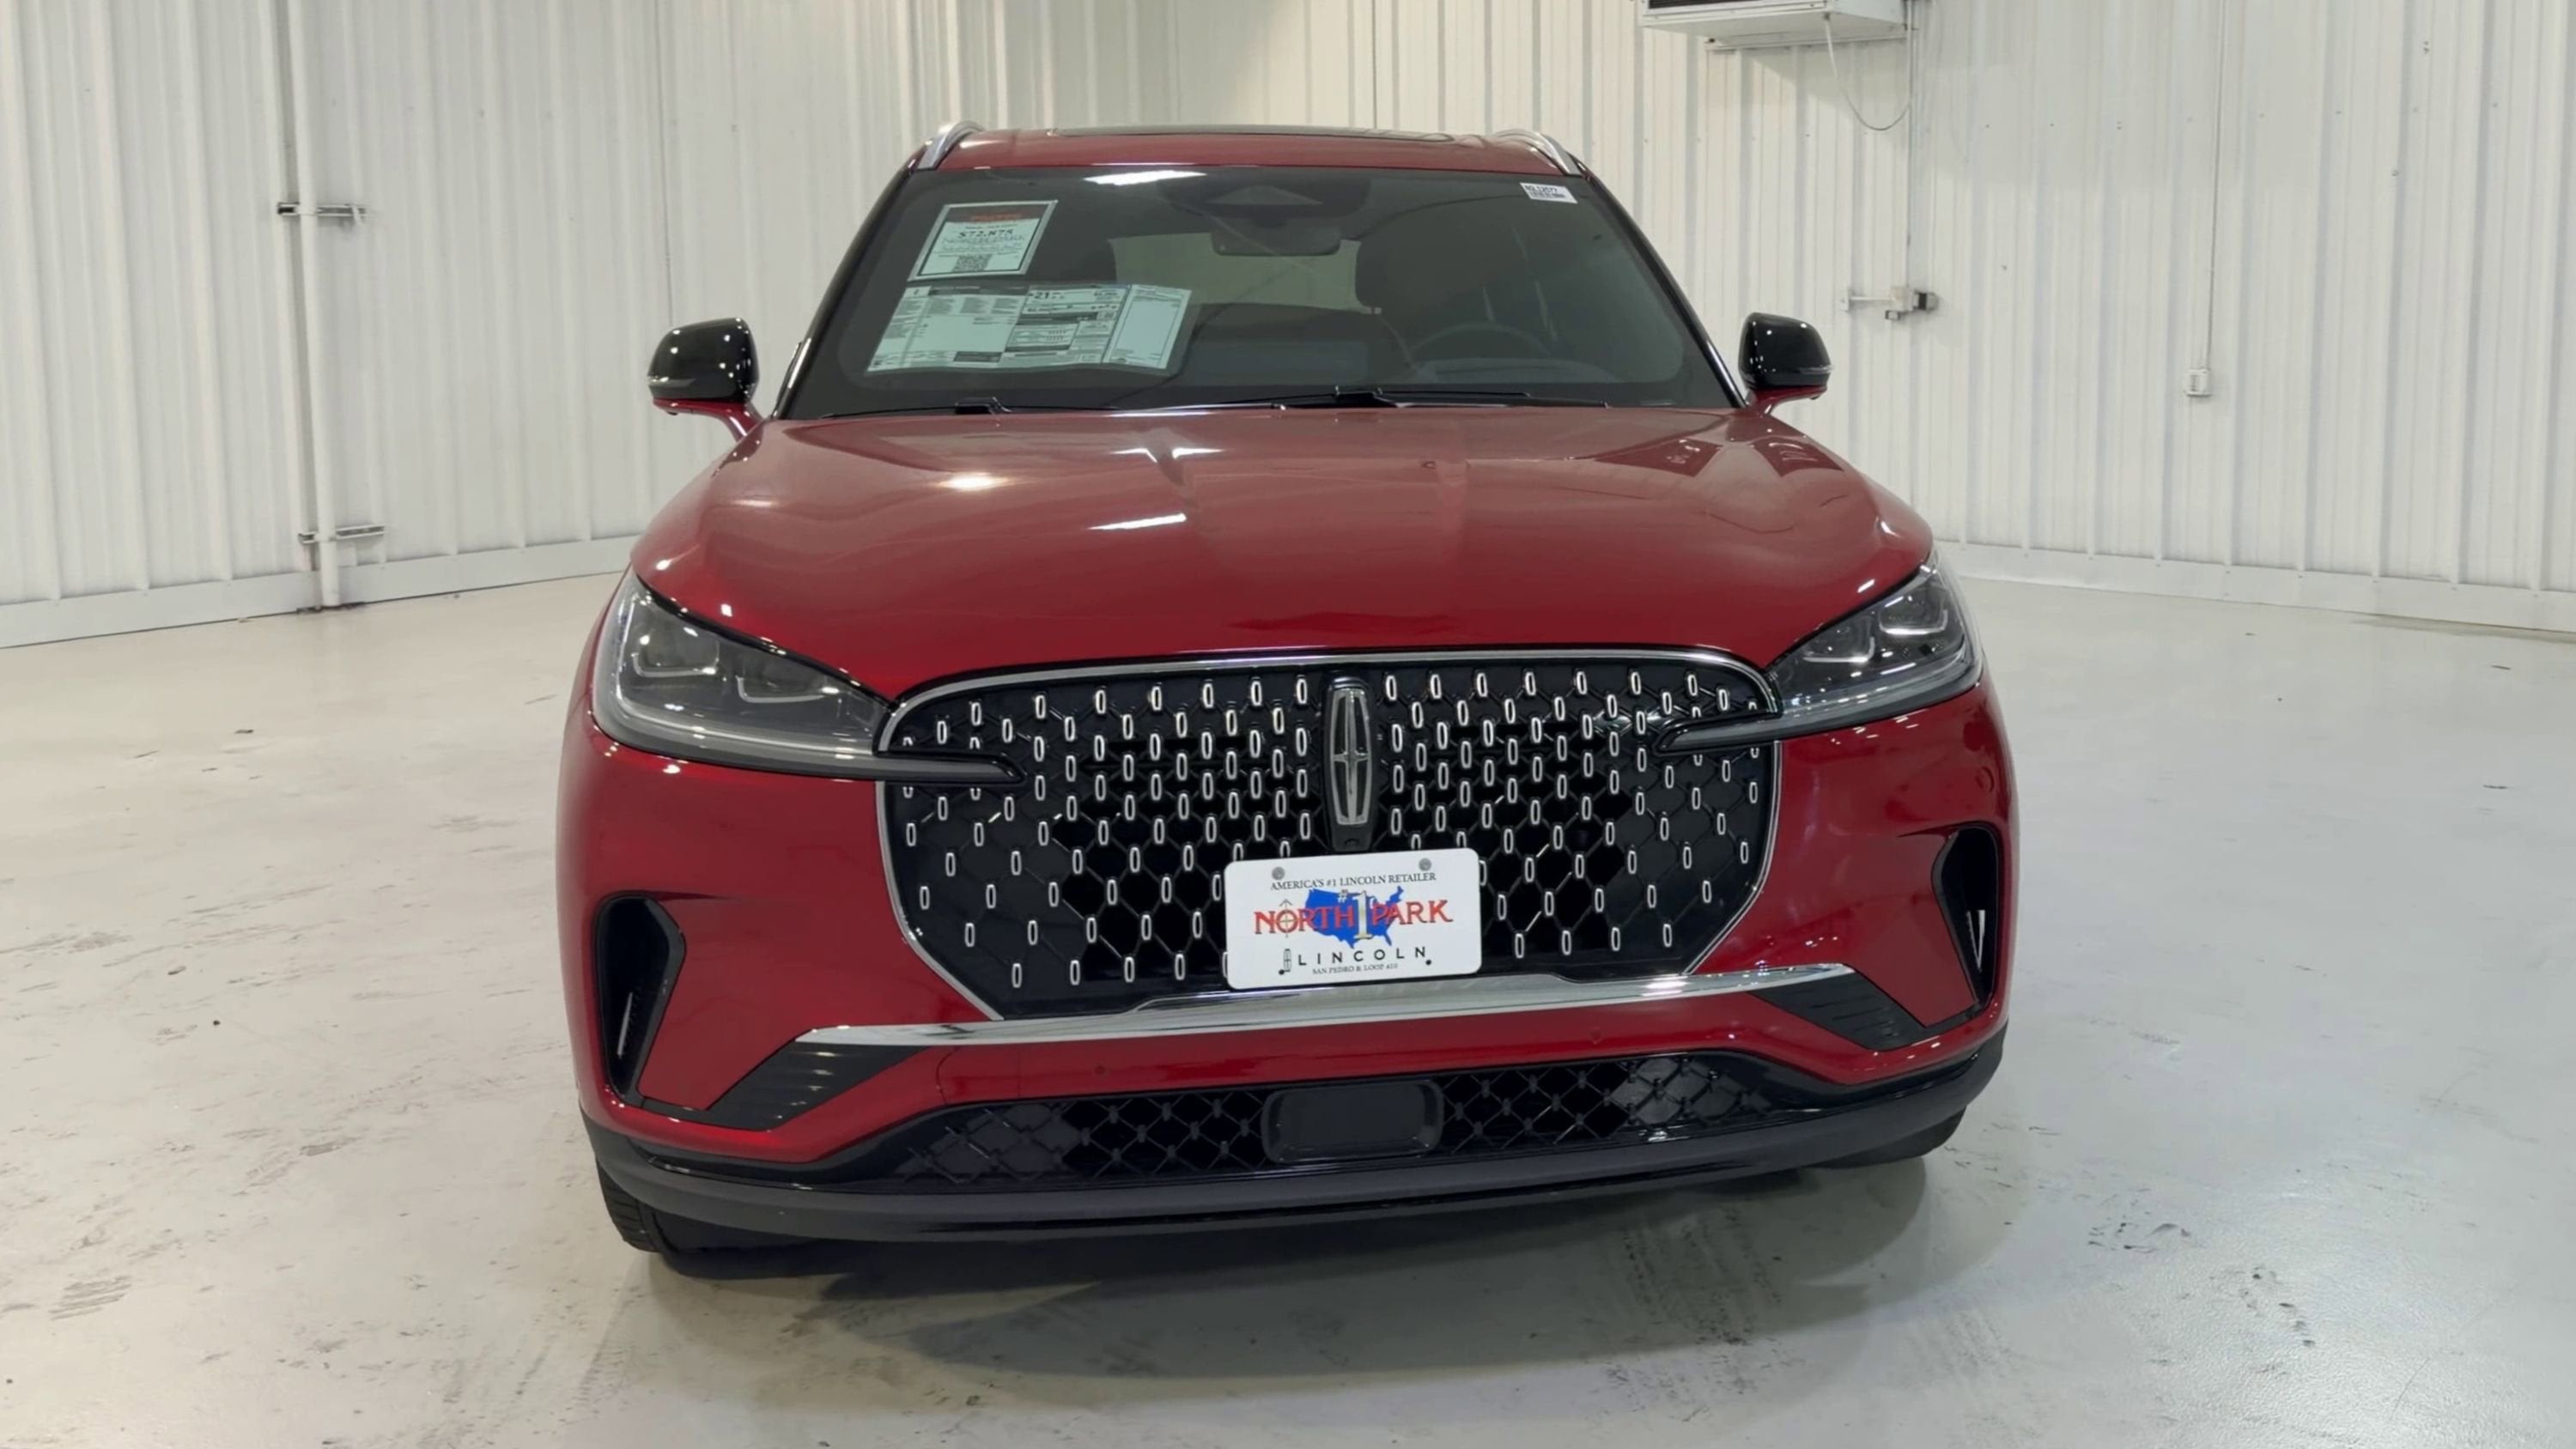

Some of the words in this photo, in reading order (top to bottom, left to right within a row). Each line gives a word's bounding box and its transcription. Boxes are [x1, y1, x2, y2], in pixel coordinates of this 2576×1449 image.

[1270, 878, 1323, 890] AMERICA'S
[1326, 878, 1337, 887] #1
[1340, 875, 1386, 887] LINCOLN
[1388, 871, 1437, 882] RETAILER
[1254, 904, 1354, 935] NORTH
[1372, 899, 1454, 929] PARK
[1297, 946, 1426, 967] LINCOLN
[1312, 967, 1328, 975] SAN
[1330, 965, 1354, 974] PEDRO
[1364, 963, 1384, 972] LOOP
